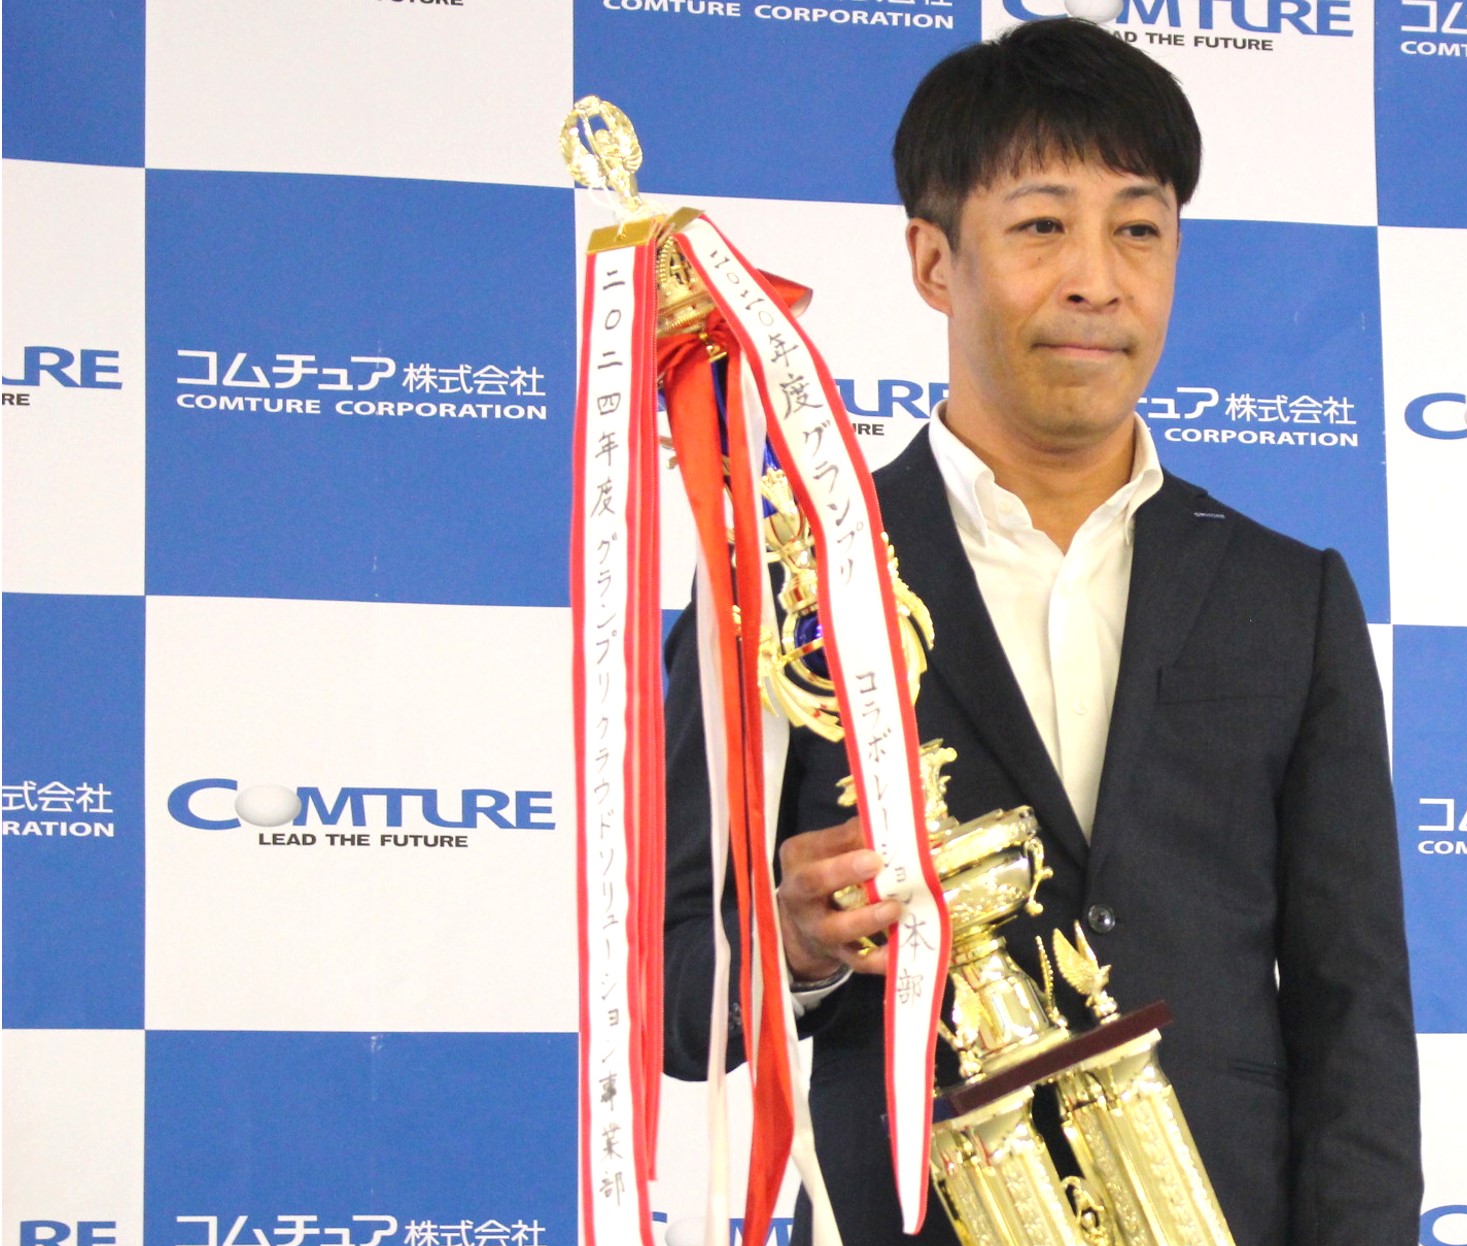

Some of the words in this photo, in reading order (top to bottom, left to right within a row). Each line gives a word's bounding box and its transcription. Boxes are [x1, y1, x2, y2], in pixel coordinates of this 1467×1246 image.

[755, 0, 953, 28] CORPORATION
[1146, 32, 1184, 46] THE
[1194, 36, 1273, 50] FUTURE
[176, 349, 547, 396] コムチュア株式会社
[177, 394, 320, 413] COMTURE
[336, 401, 546, 419] CORPORATION
[1165, 428, 1358, 446] CORPORATION
[259, 834, 316, 845] LEAD
[326, 834, 370, 846] THE
[381, 835, 468, 847] FUTURE
